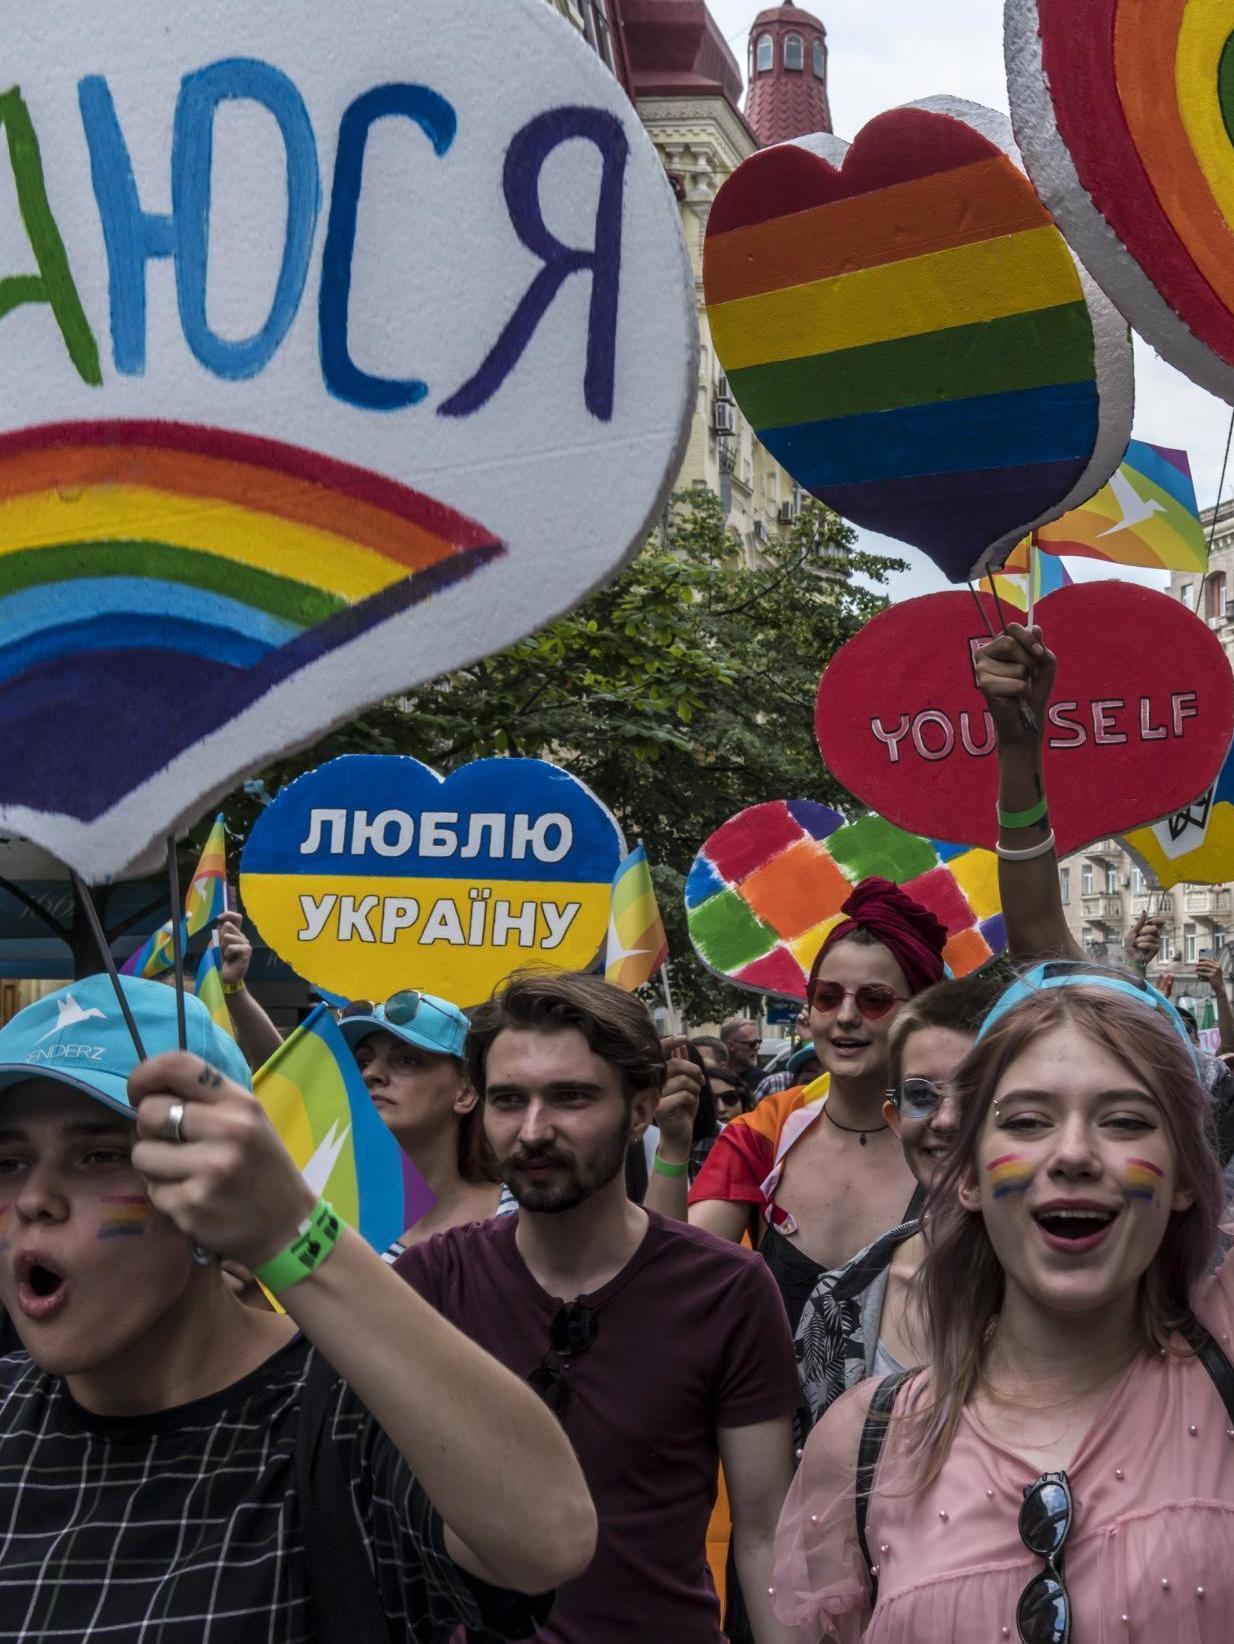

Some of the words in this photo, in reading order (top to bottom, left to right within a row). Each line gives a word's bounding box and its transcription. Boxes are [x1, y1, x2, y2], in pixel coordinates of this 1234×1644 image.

[870, 692, 1198, 763] YOUSELF
[300, 808, 573, 863] ЛЮБЛЮ
[297, 887, 582, 949] УКРАЇНУ
